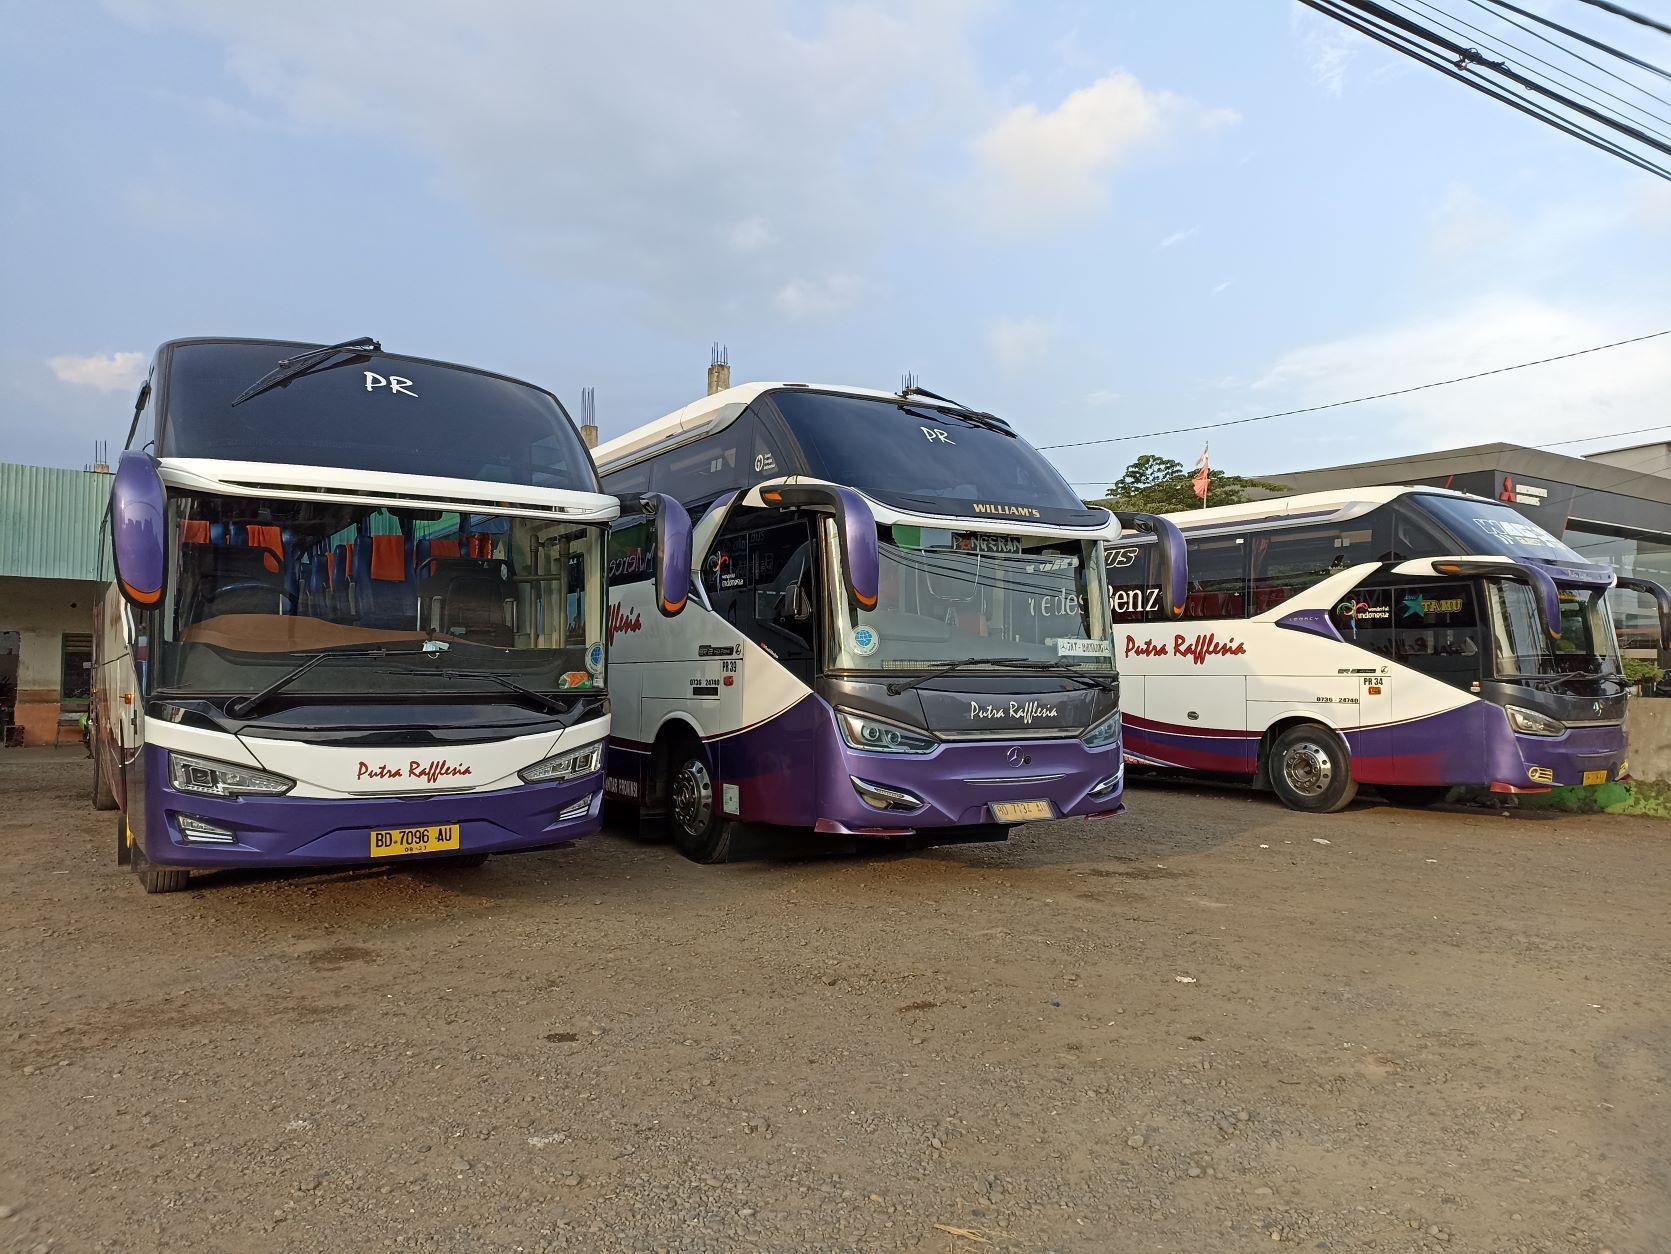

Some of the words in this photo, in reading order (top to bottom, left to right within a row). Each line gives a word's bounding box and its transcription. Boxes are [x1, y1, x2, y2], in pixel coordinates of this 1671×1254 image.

[363, 370, 420, 399] PR
[919, 426, 957, 446] PR
[973, 503, 1041, 518] WILLIAM'S
[1125, 634, 1168, 660] Putra
[1173, 633, 1247, 665] Rafflesia
[1363, 677, 1373, 686] PR
[1374, 677, 1384, 686] 34
[970, 701, 1005, 720] Putra
[1009, 701, 1058, 724] Rafflesia
[357, 761, 402, 781] Putra
[408, 760, 473, 784] Rafflesia
[375, 832, 393, 848] BD
[399, 829, 430, 846] 7096
[437, 827, 452, 842] AU
